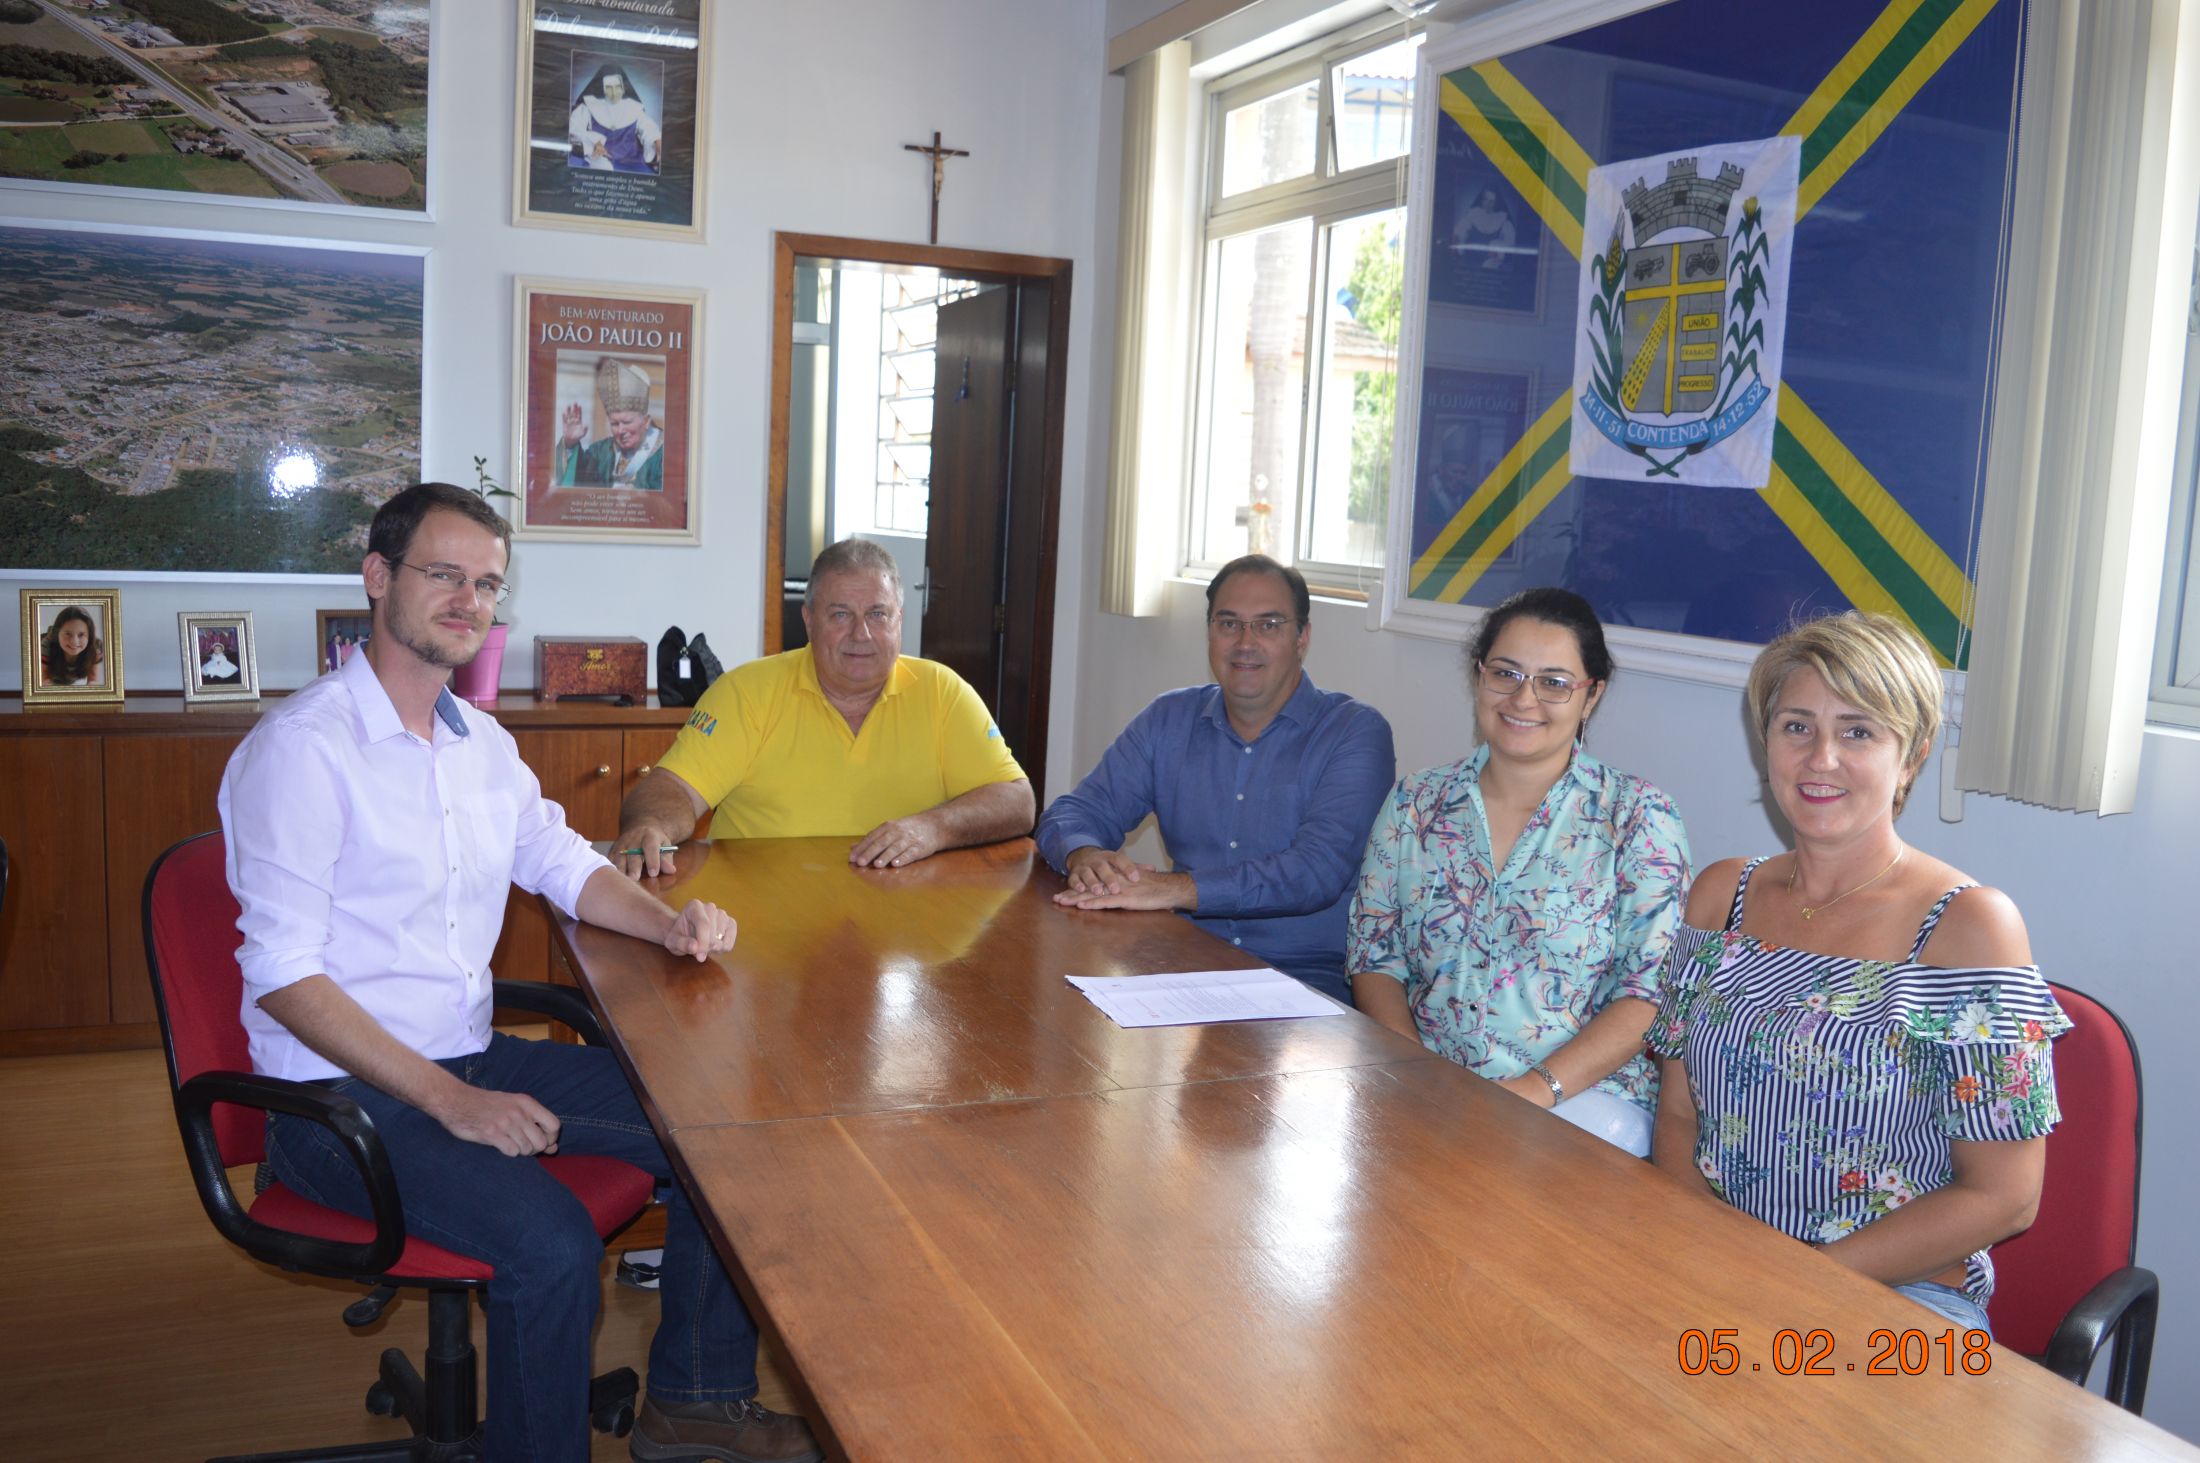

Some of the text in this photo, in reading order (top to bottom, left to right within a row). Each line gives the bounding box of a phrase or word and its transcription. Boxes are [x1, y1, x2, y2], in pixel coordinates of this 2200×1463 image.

[560, 306, 664, 324] BEM-AVENTURADO
[541, 322, 682, 349] JOÃO PAULO II
[1627, 420, 1709, 443] CONTENDA
